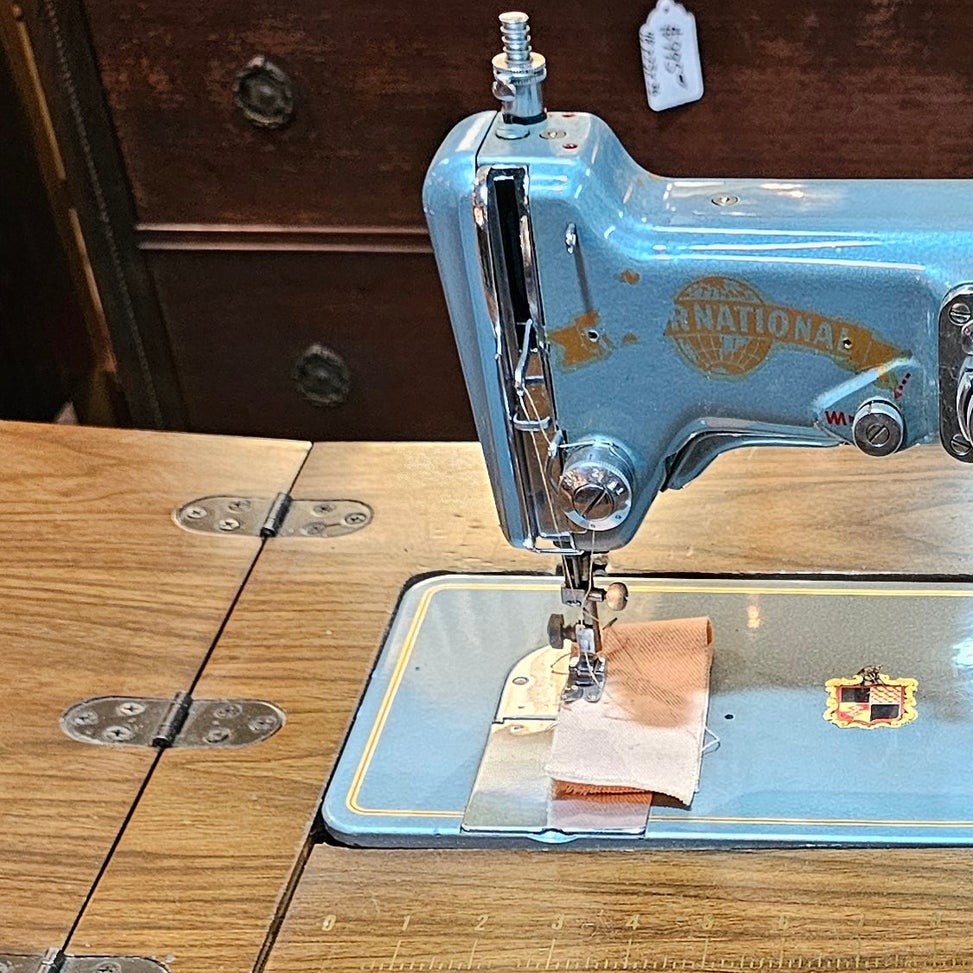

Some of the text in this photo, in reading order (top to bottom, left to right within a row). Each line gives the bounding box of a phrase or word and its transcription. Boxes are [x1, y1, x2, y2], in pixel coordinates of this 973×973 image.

[402, 915, 411, 931] 1
[474, 914, 489, 931] 2
[625, 914, 641, 931] 4
